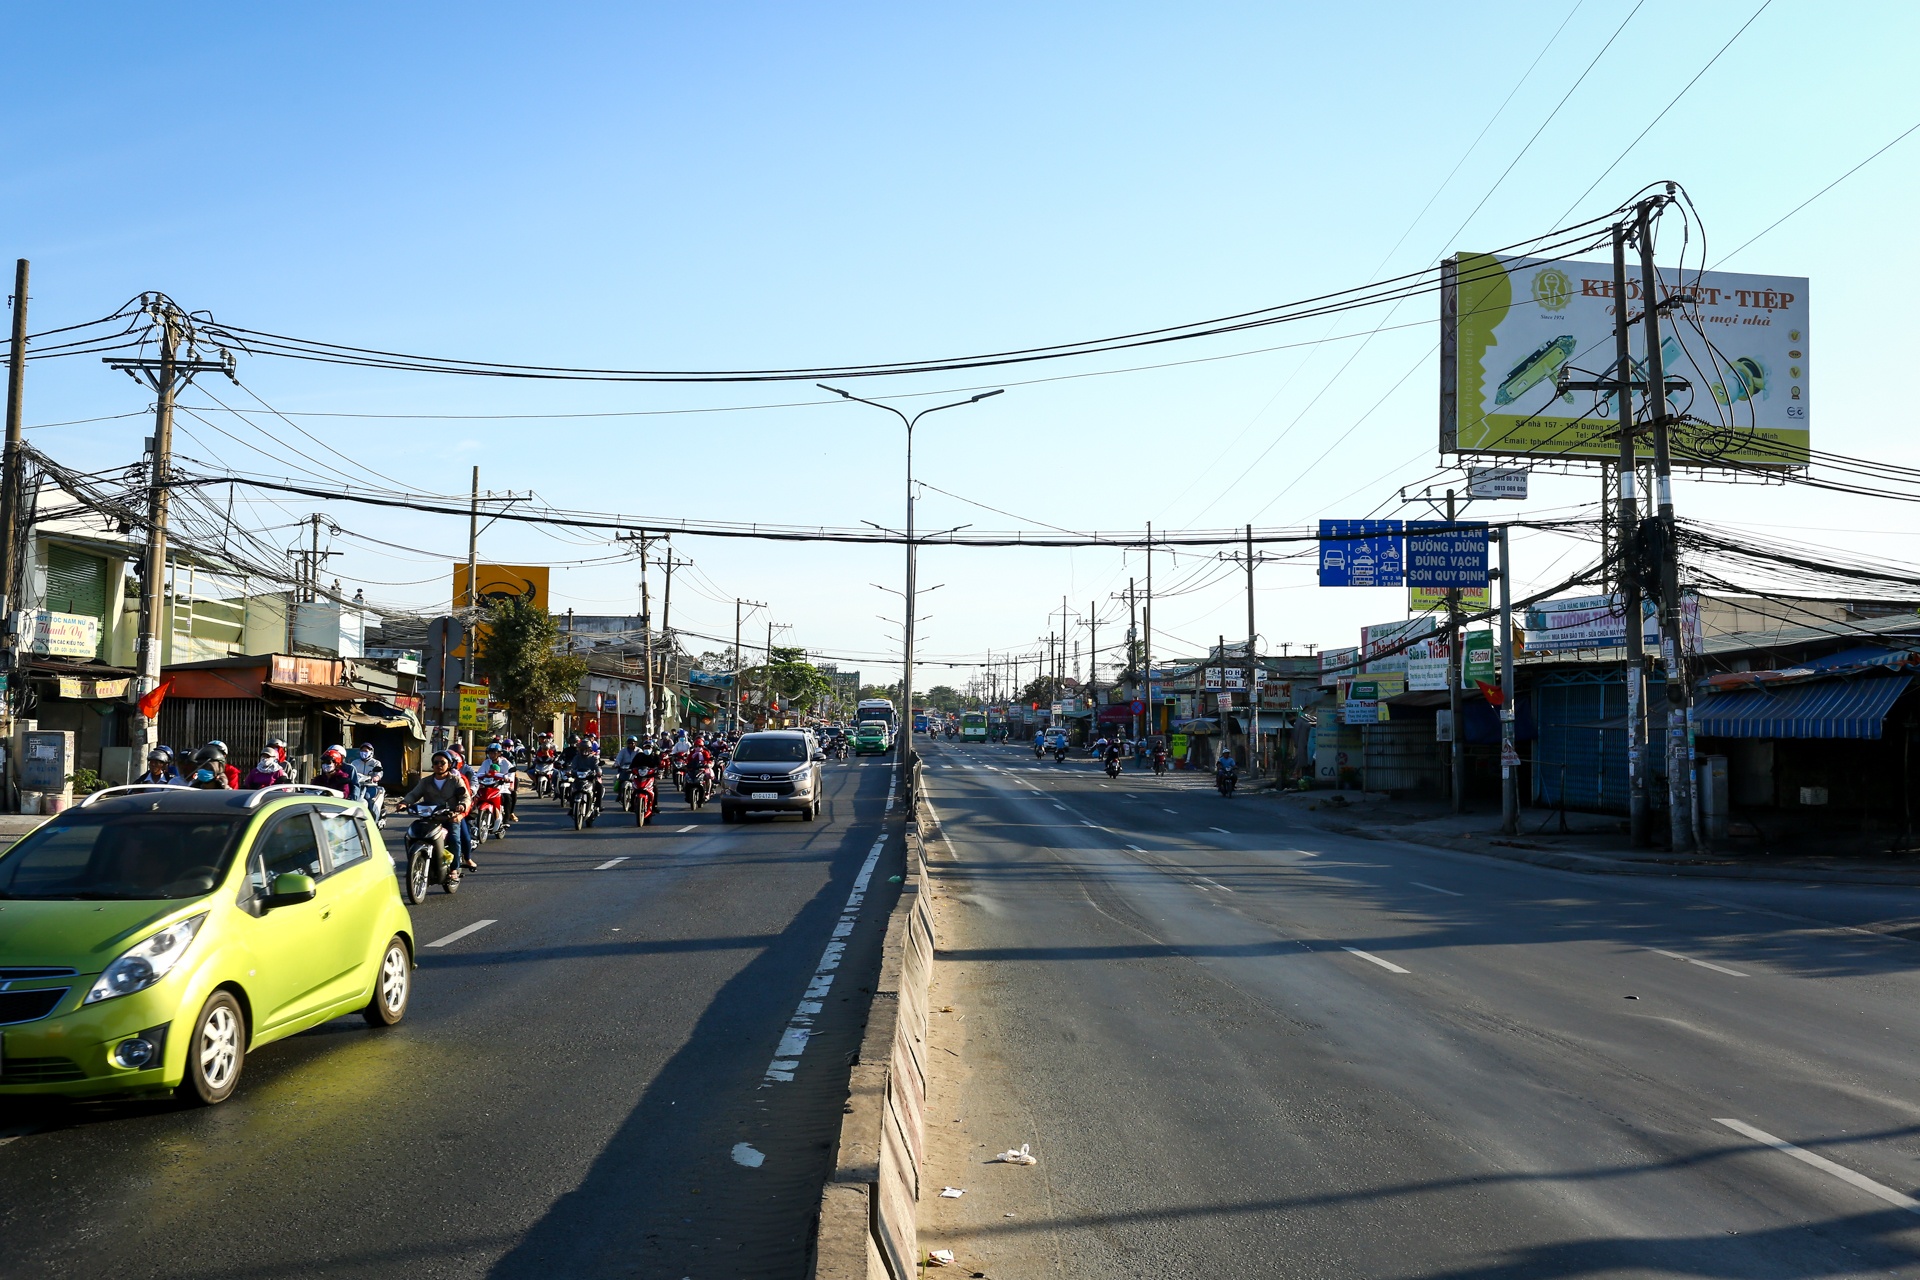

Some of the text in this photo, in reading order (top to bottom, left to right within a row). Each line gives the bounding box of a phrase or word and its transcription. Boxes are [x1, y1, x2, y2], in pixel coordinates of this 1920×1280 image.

[1580, 277, 1646, 301] KHÓ
[1734, 288, 1795, 314] TIỆP
[1710, 314, 1738, 327] mọi
[1742, 313, 1772, 327] nhà
[1410, 538, 1448, 552] ĐƯỜNG
[1415, 553, 1480, 568] ĐÚNG VẠCH
[1410, 568, 1486, 584] SƠN QUY ĐỊNH
[1580, 600, 1589, 608] MÁY
[1474, 650, 1490, 662] Castrol
